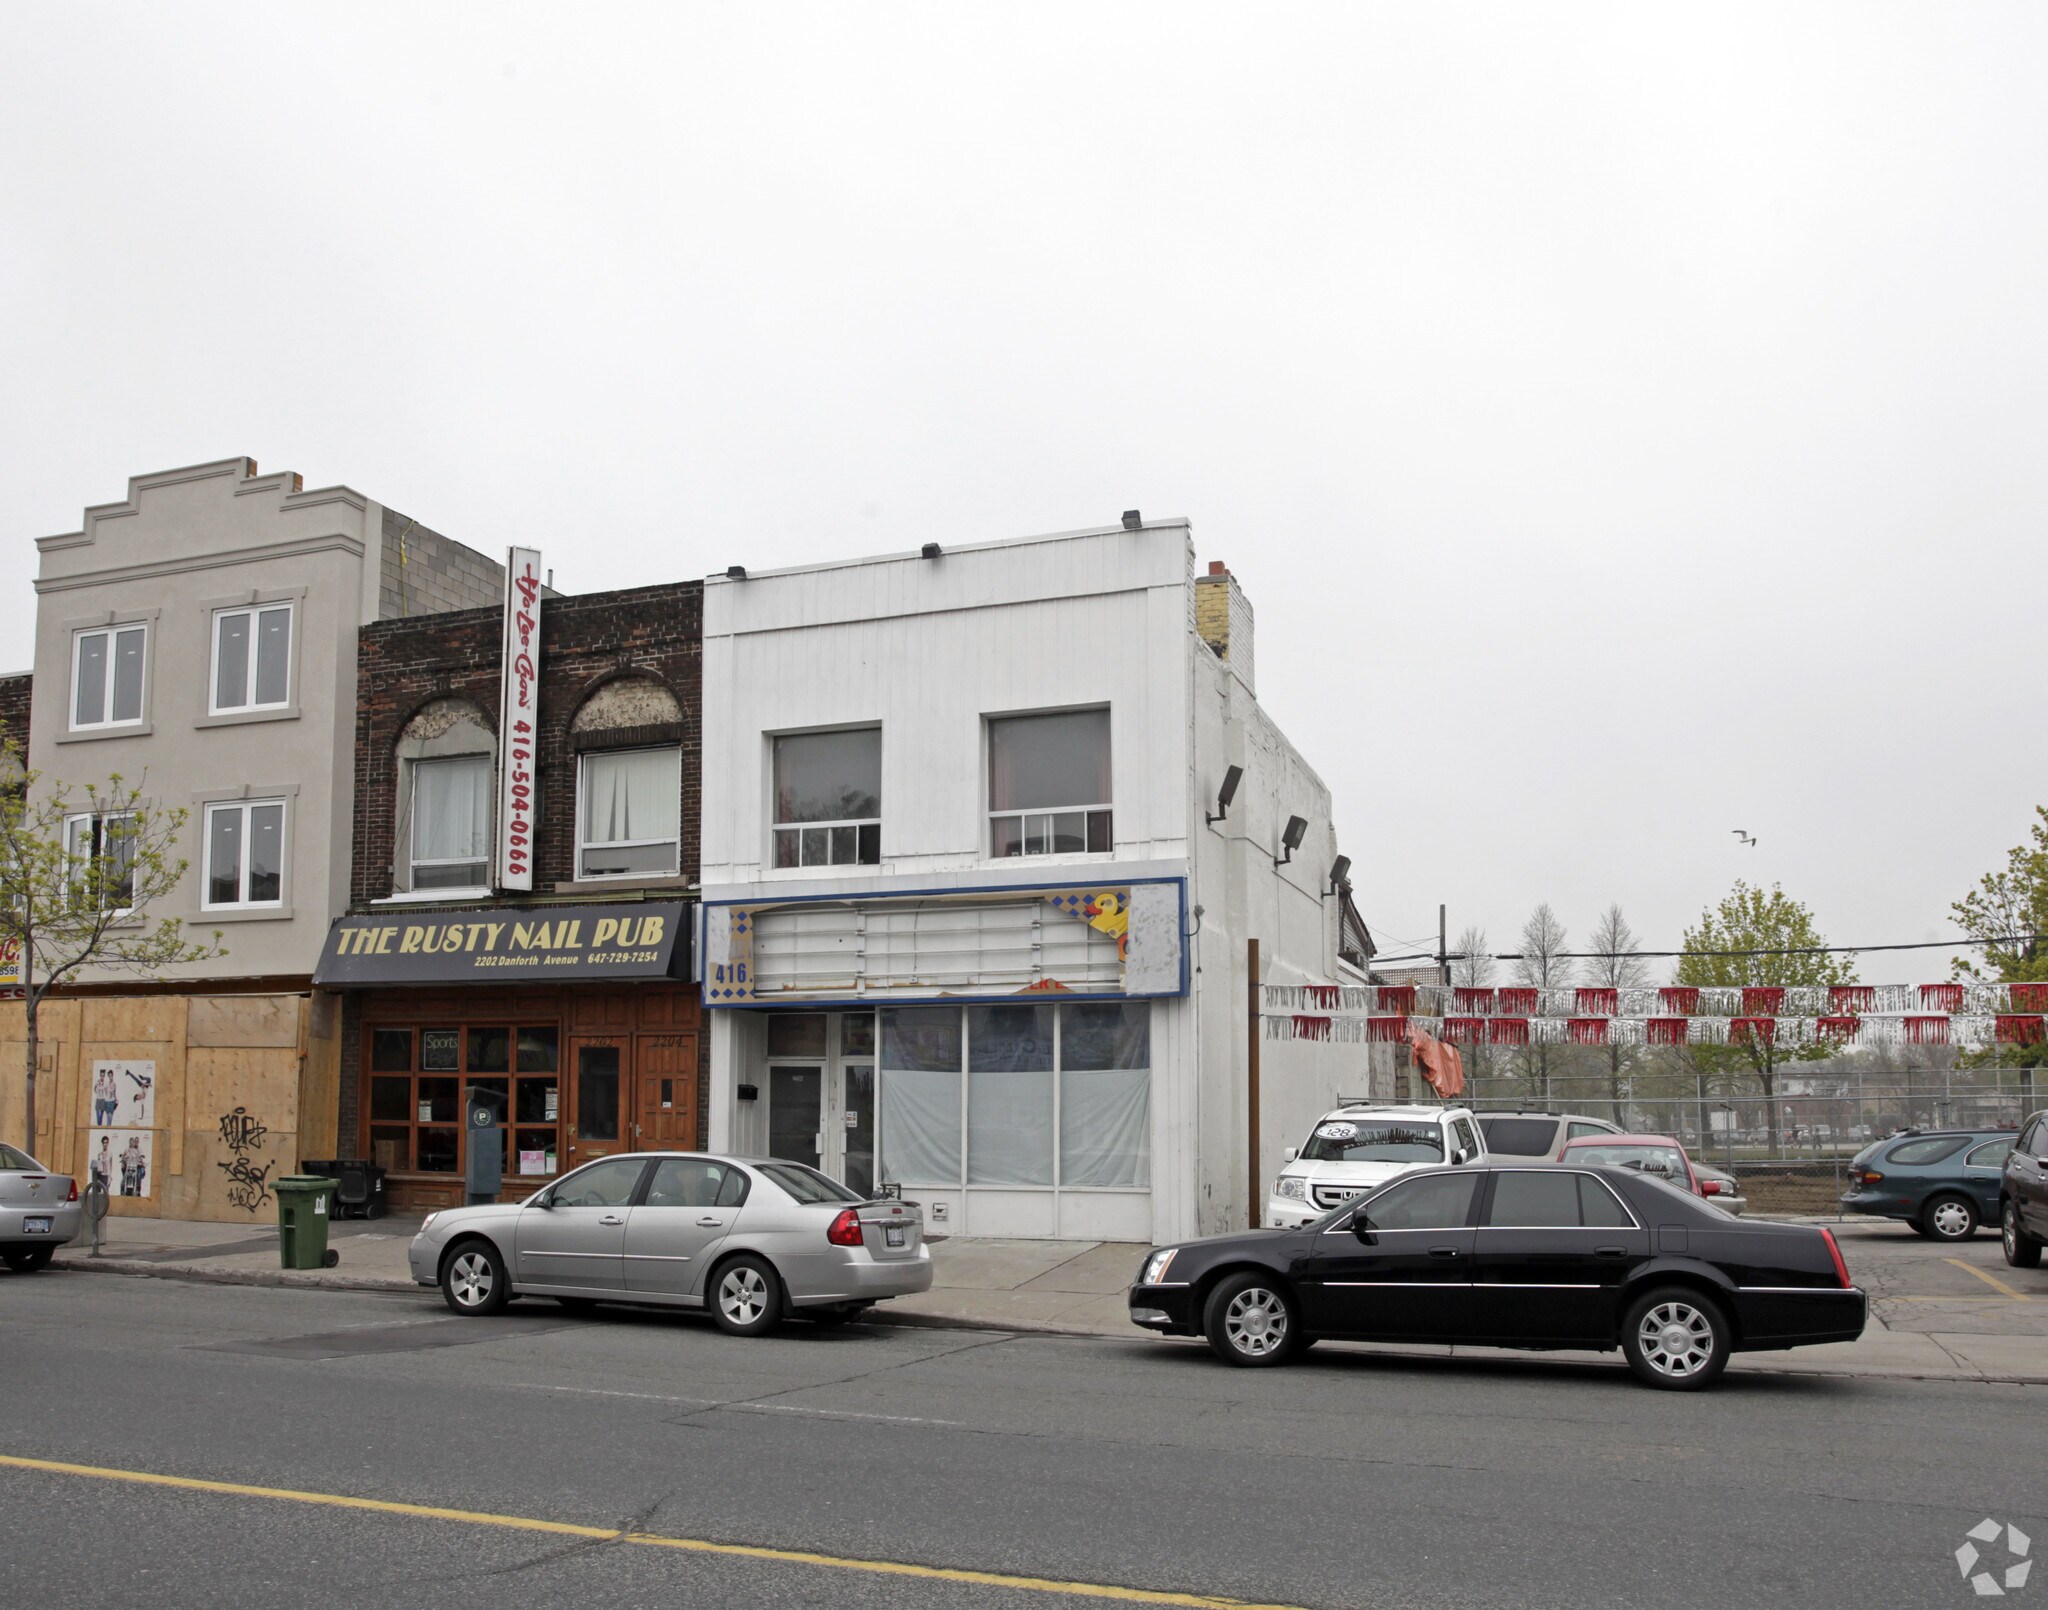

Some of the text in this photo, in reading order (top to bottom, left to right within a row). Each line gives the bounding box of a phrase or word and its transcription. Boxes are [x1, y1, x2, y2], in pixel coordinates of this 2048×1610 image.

[508, 719, 532, 875] 416-504-0666
[336, 916, 665, 955] THE RUSTY NAIL PUB
[473, 951, 659, 967] 2202 Danforth Avenue 647-729-7254
[426, 1034, 458, 1050] Sports
